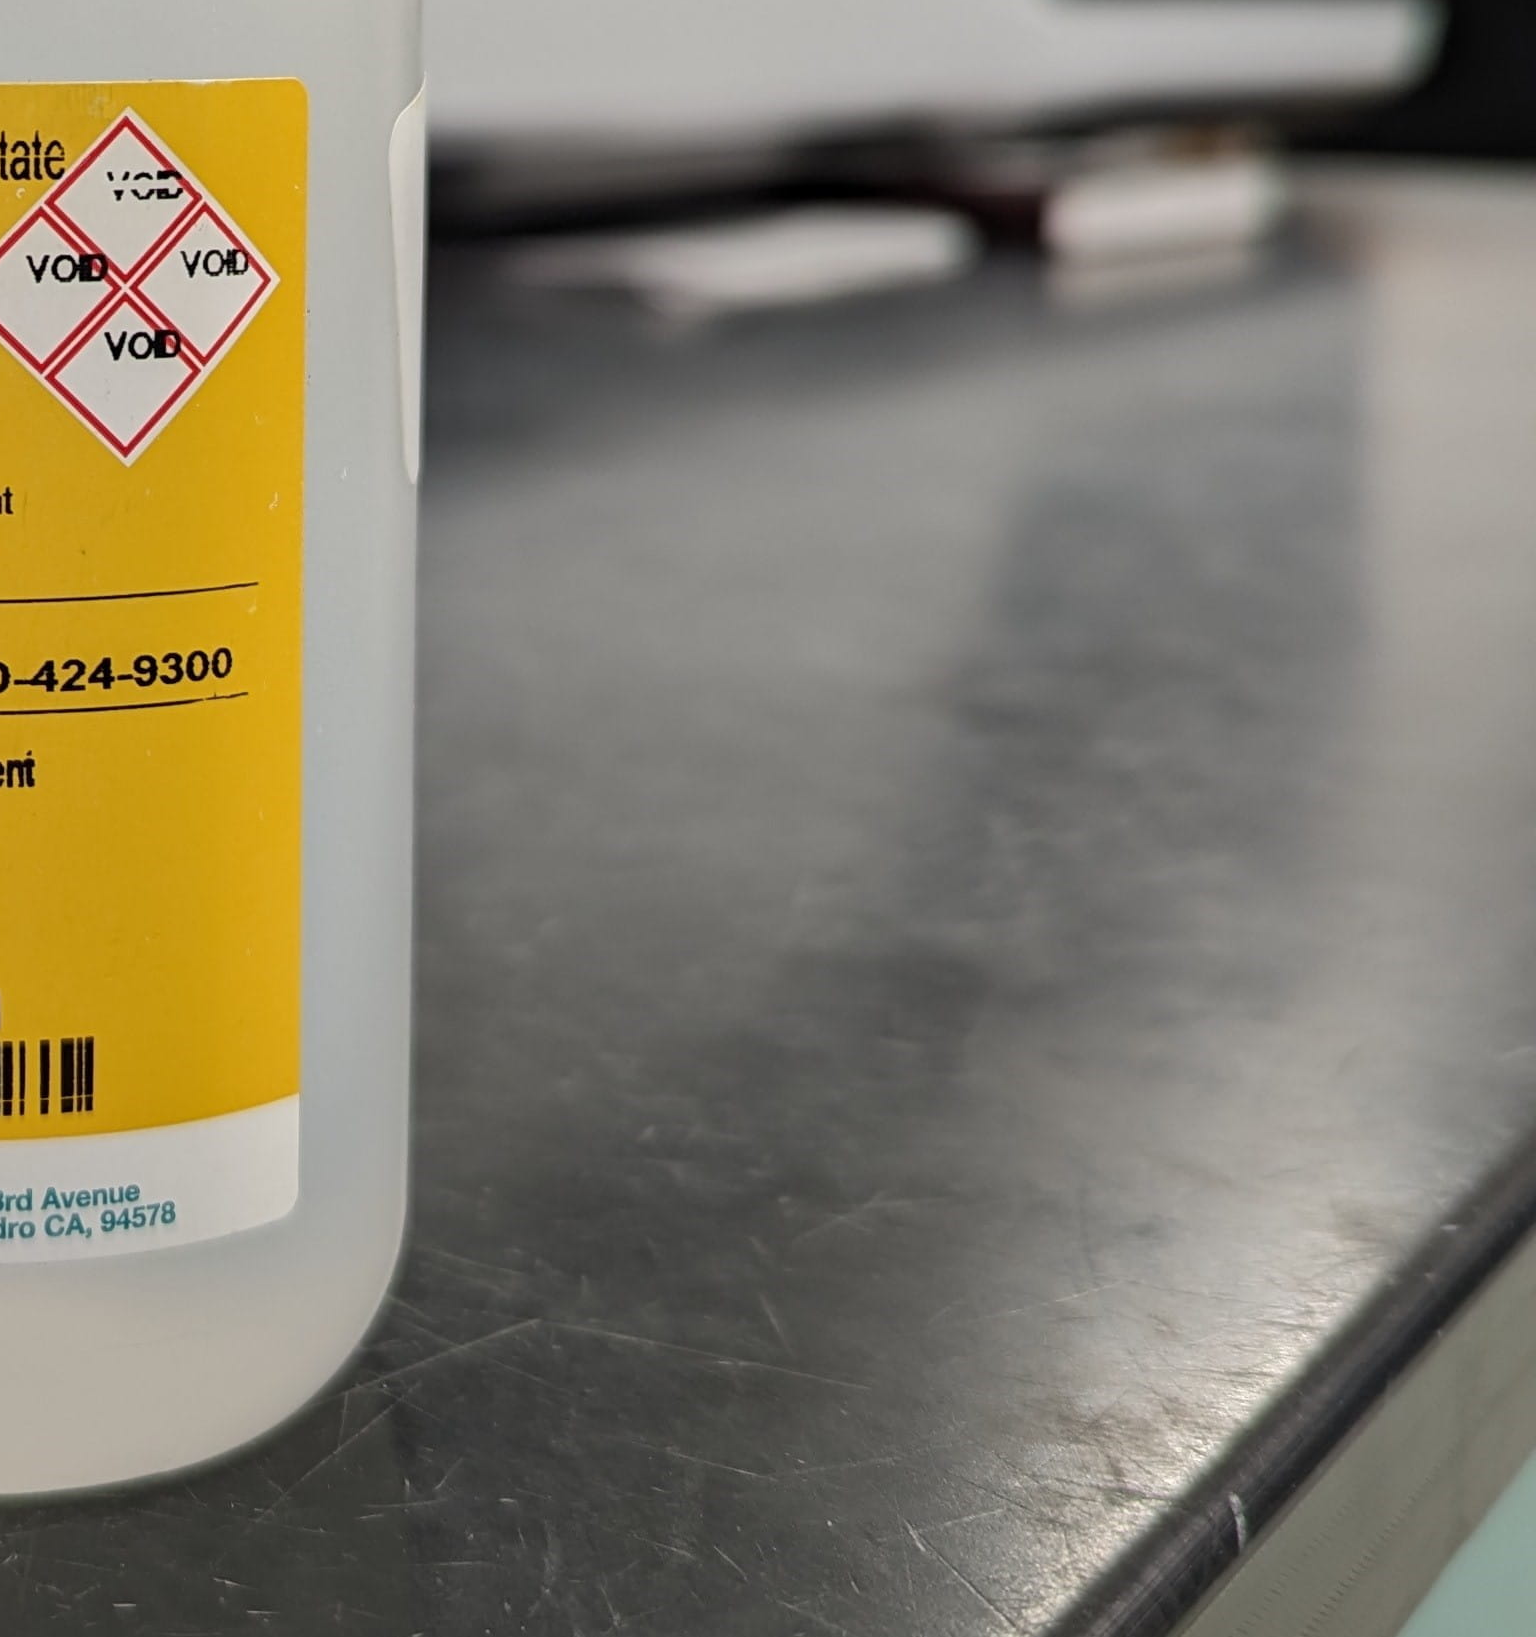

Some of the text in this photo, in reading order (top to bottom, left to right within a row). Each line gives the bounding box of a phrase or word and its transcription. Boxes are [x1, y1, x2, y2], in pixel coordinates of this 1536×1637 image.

[26, 253, 109, 283] VOID
[180, 248, 250, 278] VOID
[104, 329, 182, 361] VOID
[40, 1183, 141, 1212] Avenue
[44, 1213, 93, 1240] CA,
[99, 1199, 176, 1233] 94578
